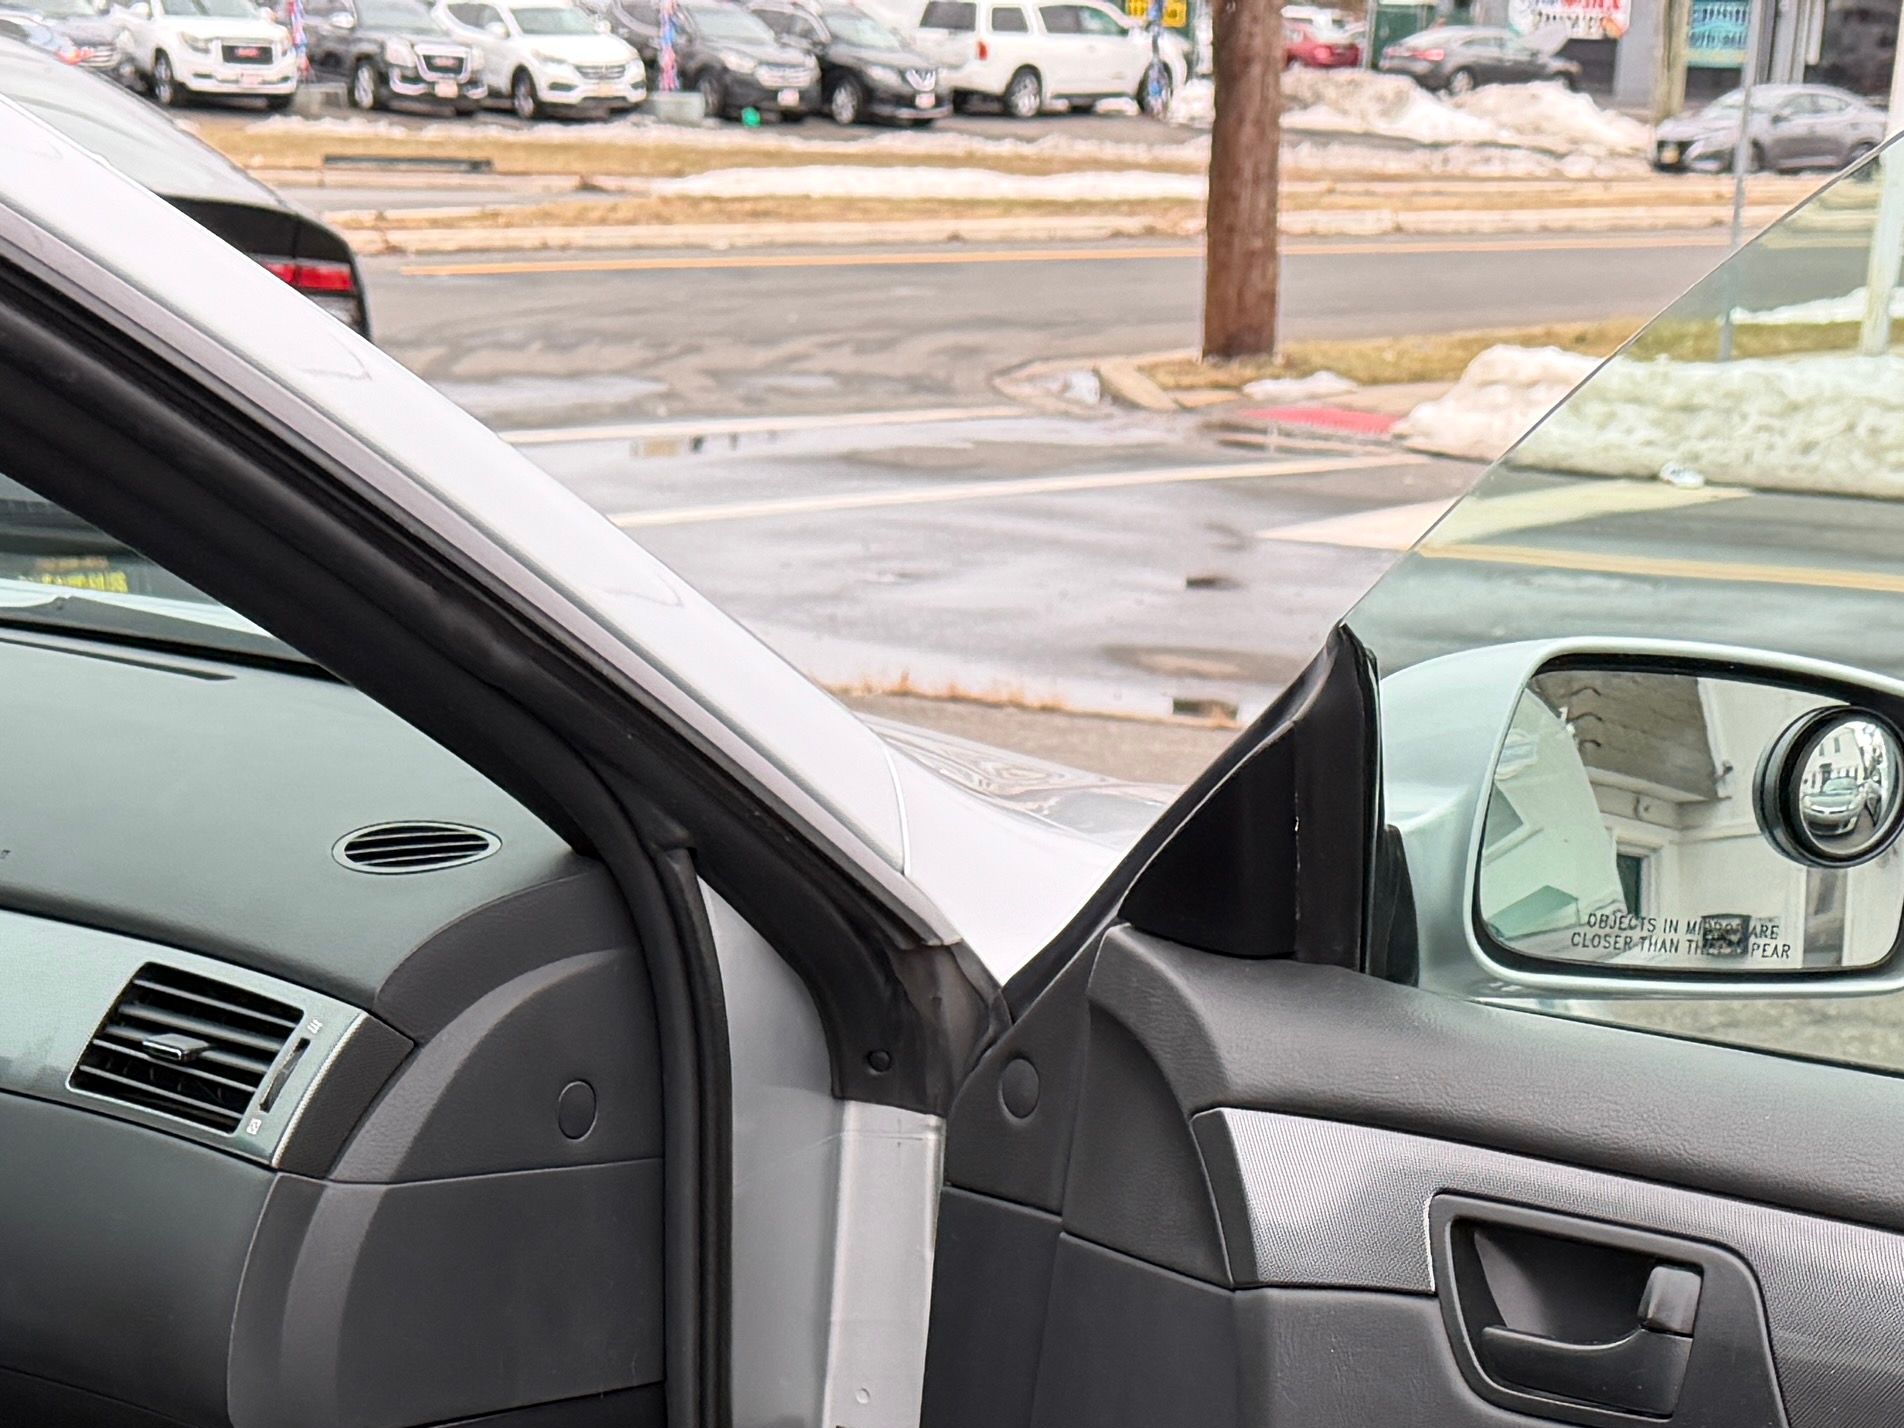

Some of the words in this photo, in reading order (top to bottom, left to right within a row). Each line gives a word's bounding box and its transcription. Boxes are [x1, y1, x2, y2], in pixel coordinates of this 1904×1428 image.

[1586, 912, 1657, 933] OBJECTS
[1663, 918, 1679, 934] IN
[1749, 923, 1780, 941] ARE
[1571, 931, 1633, 951] CLOSER
[1639, 935, 1680, 954] THAN
